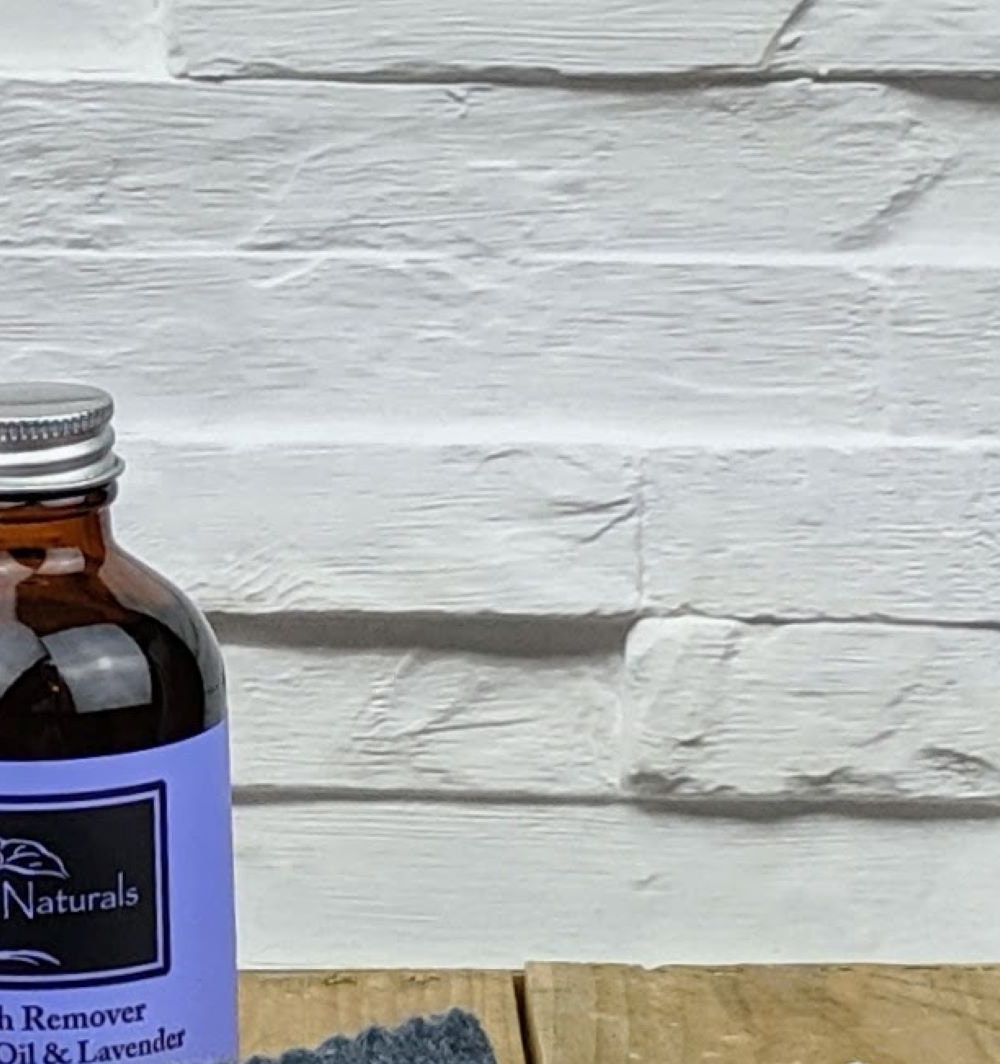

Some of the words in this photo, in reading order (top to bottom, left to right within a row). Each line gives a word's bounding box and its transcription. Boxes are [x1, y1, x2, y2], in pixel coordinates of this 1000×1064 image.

[2, 871, 140, 920] Naturals
[21, 1002, 147, 1032] Remover
[77, 1027, 187, 1064] Lavender
